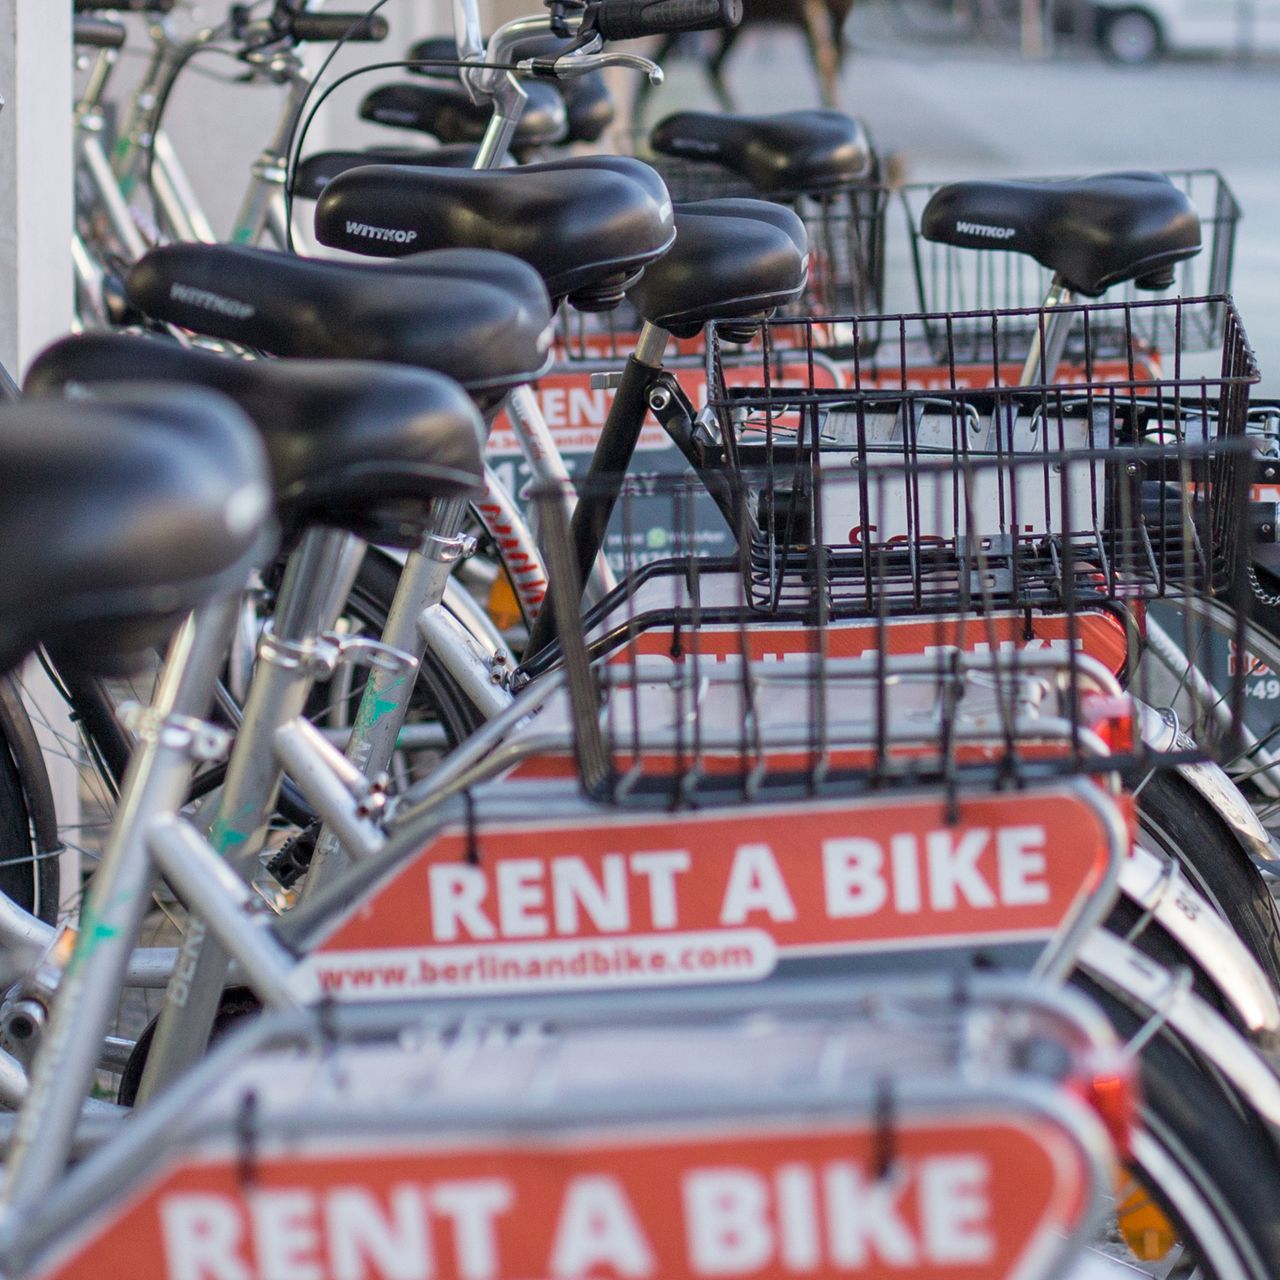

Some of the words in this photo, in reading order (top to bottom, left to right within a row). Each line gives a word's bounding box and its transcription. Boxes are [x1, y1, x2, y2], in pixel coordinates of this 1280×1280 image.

[346, 220, 417, 244] WITTKOP
[956, 221, 1016, 240] WITTKOP
[170, 282, 256, 319] WITTKOP
[428, 850, 692, 942] RENT
[720, 842, 797, 926] A
[822, 825, 1050, 922] BIKE
[319, 944, 754, 993] www.berlinandbike.com
[158, 1176, 516, 1280] RENT
[548, 1171, 660, 1280] A
[681, 1153, 996, 1278] BIKE
